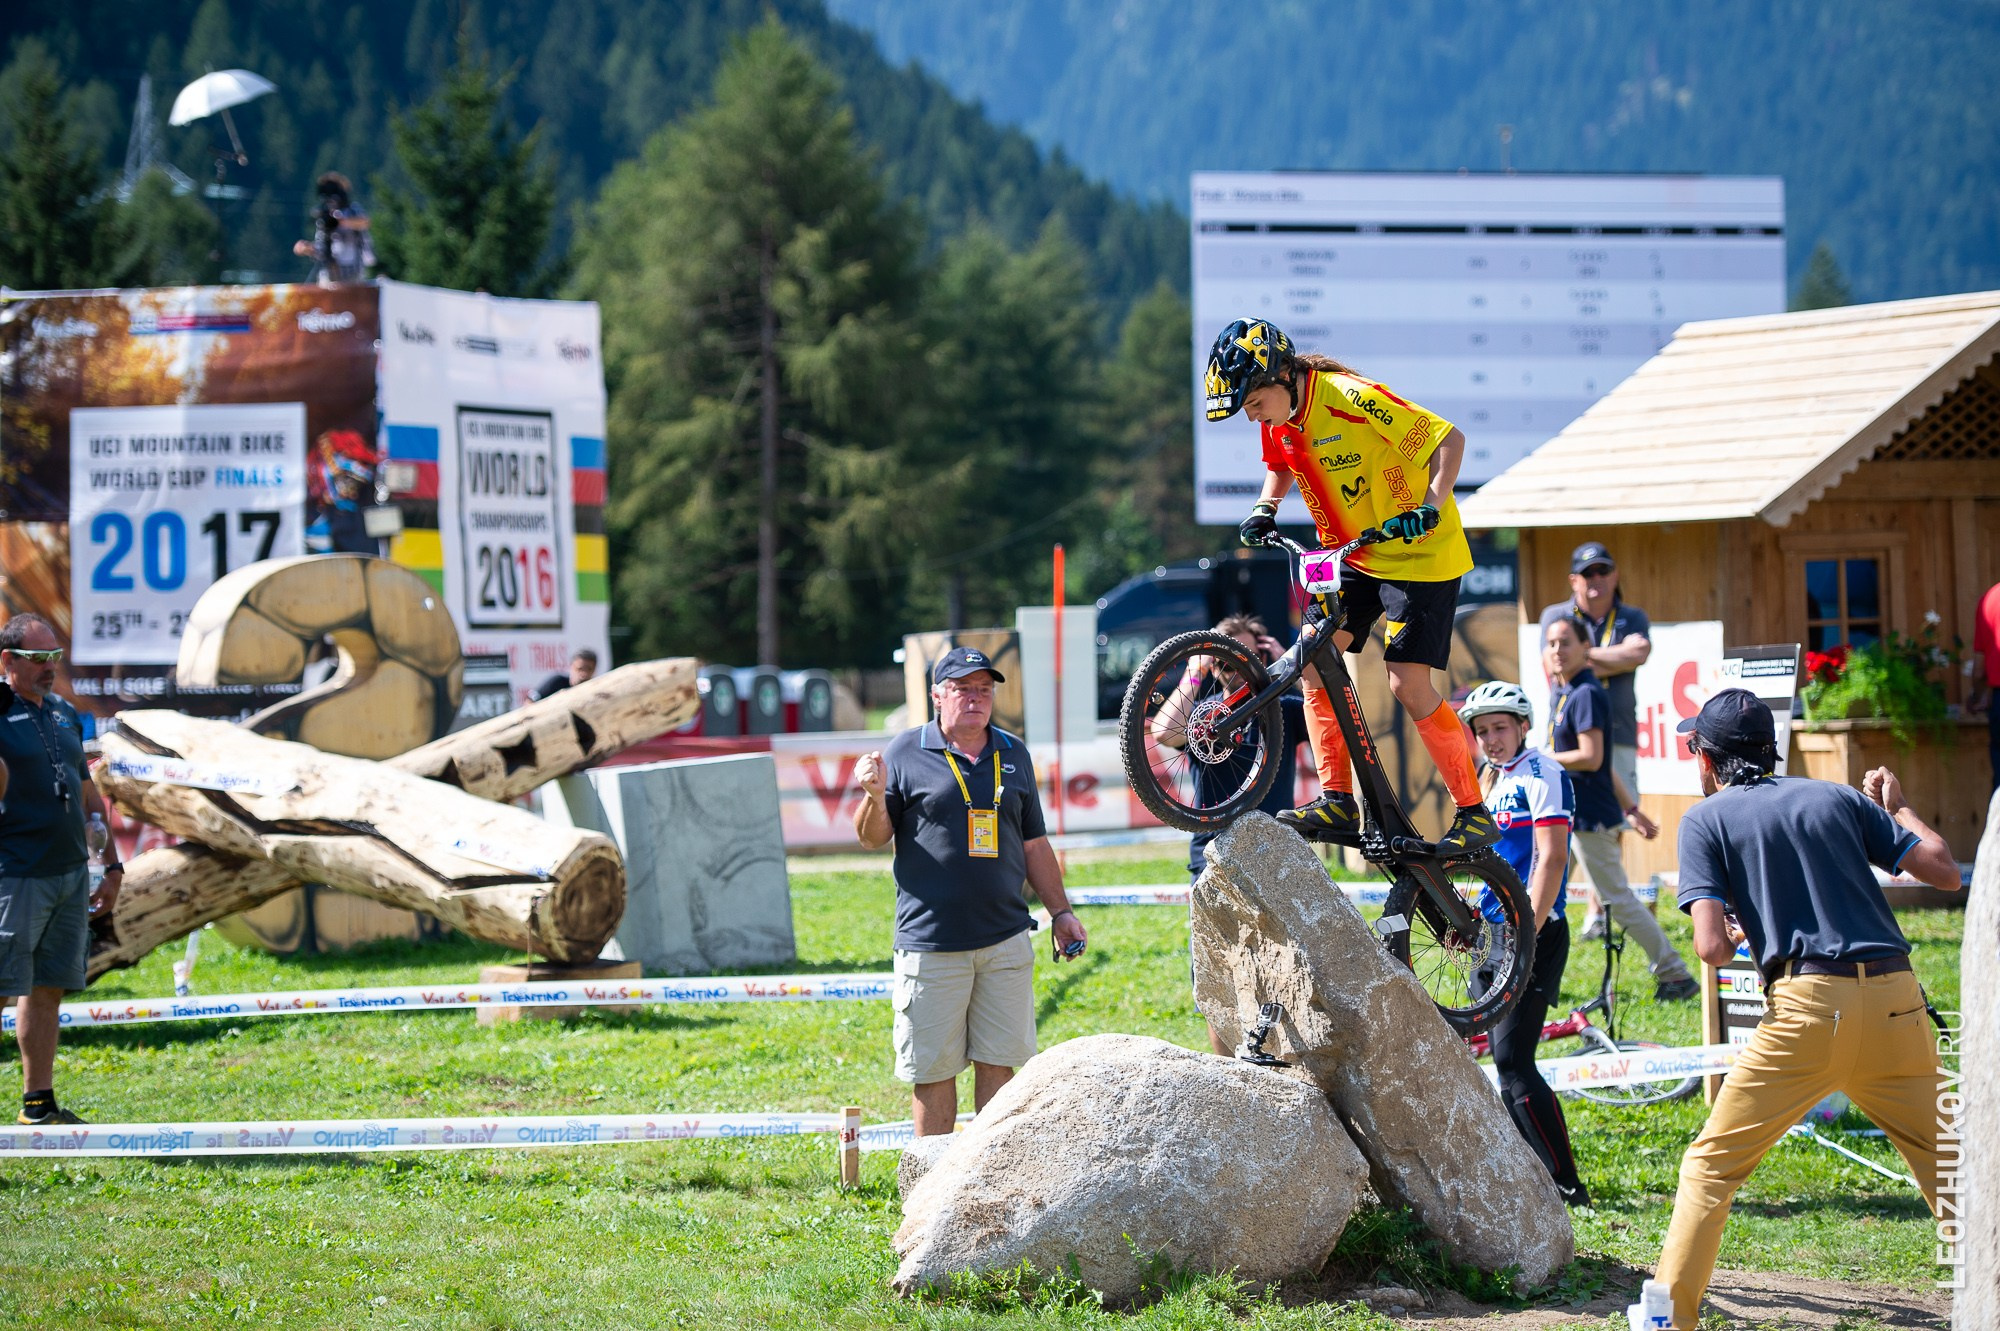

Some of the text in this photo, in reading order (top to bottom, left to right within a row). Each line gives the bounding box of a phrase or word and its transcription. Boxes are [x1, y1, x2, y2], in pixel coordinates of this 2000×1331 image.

[90, 431, 285, 457] UCI MOUNTAIN BIKE
[1398, 416, 1430, 461] ESP
[90, 466, 283, 491] WORLD CUP FINALS
[469, 452, 547, 497] WORLD
[91, 510, 281, 591] 2017
[478, 545, 554, 609] 2016
[169, 610, 191, 638] 2
[71, 678, 101, 695] VAL
[121, 677, 166, 695] SOLE
[1343, 686, 1375, 765] MONTY
[171, 1003, 240, 1017] TRENTINO
[501, 990, 568, 1003] TRENTINO
[662, 985, 728, 1000] TRENTINO
[821, 981, 887, 998] TRENTINO
[1734, 976, 1755, 993] UCI
